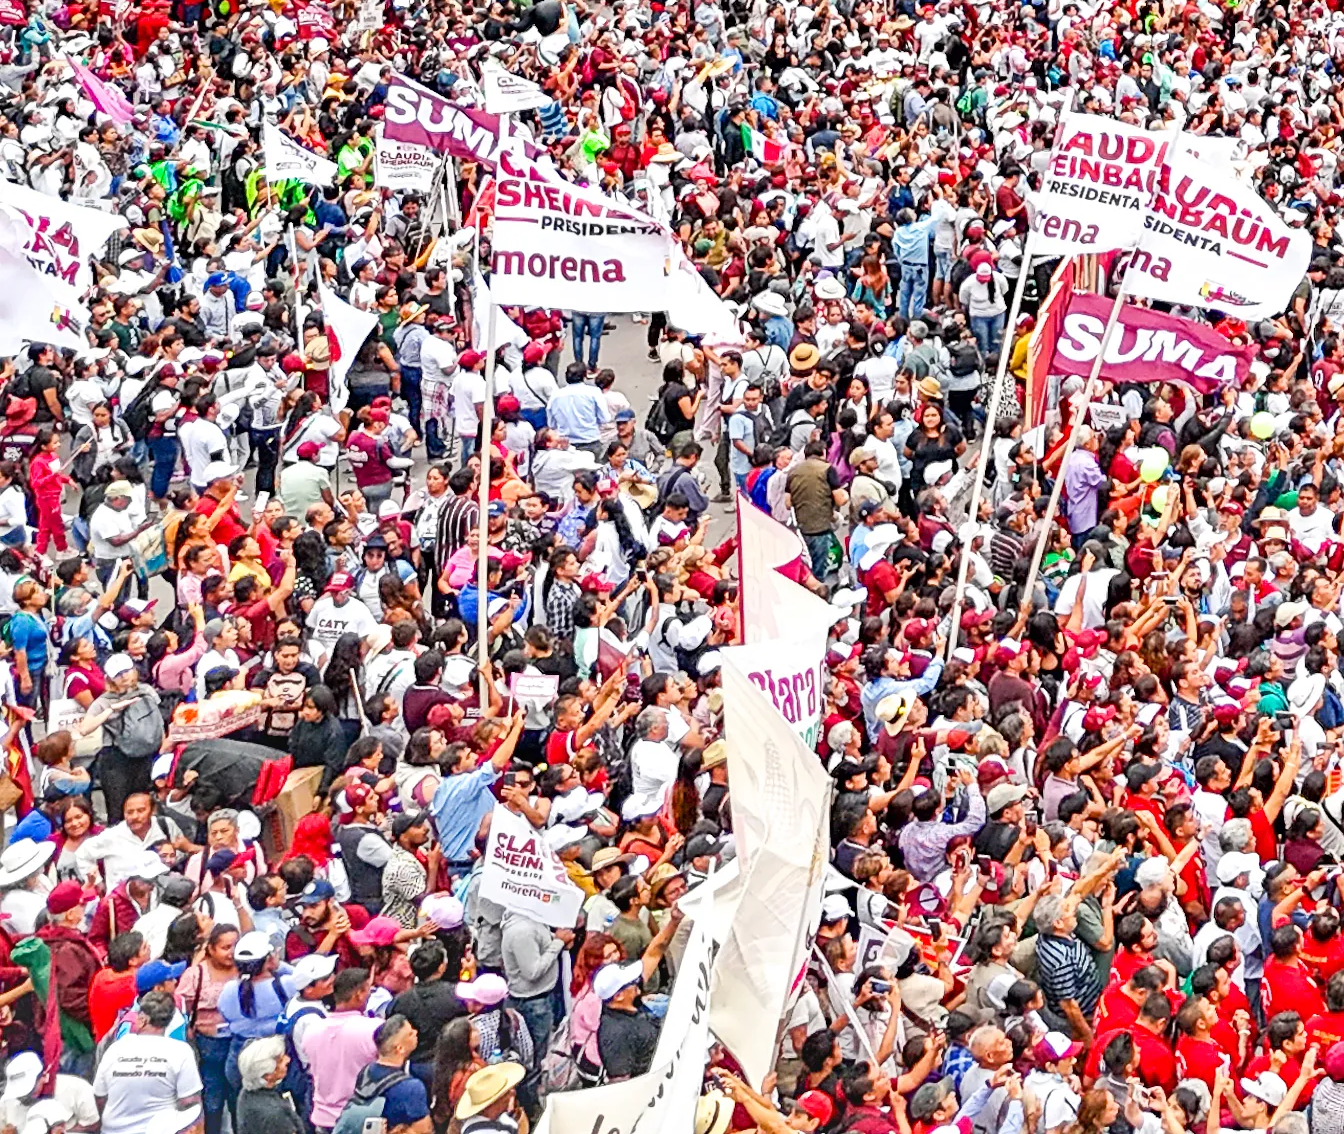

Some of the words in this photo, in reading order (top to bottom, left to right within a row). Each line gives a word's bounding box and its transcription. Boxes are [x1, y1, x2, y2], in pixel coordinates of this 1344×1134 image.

[541, 215, 662, 237] PRESIDENTA
[1144, 215, 1222, 256] SIDENTA
[491, 249, 626, 283] morena
[1130, 247, 1173, 283] na
[1056, 312, 1238, 382] SUMA
[319, 619, 350, 630] CATY
